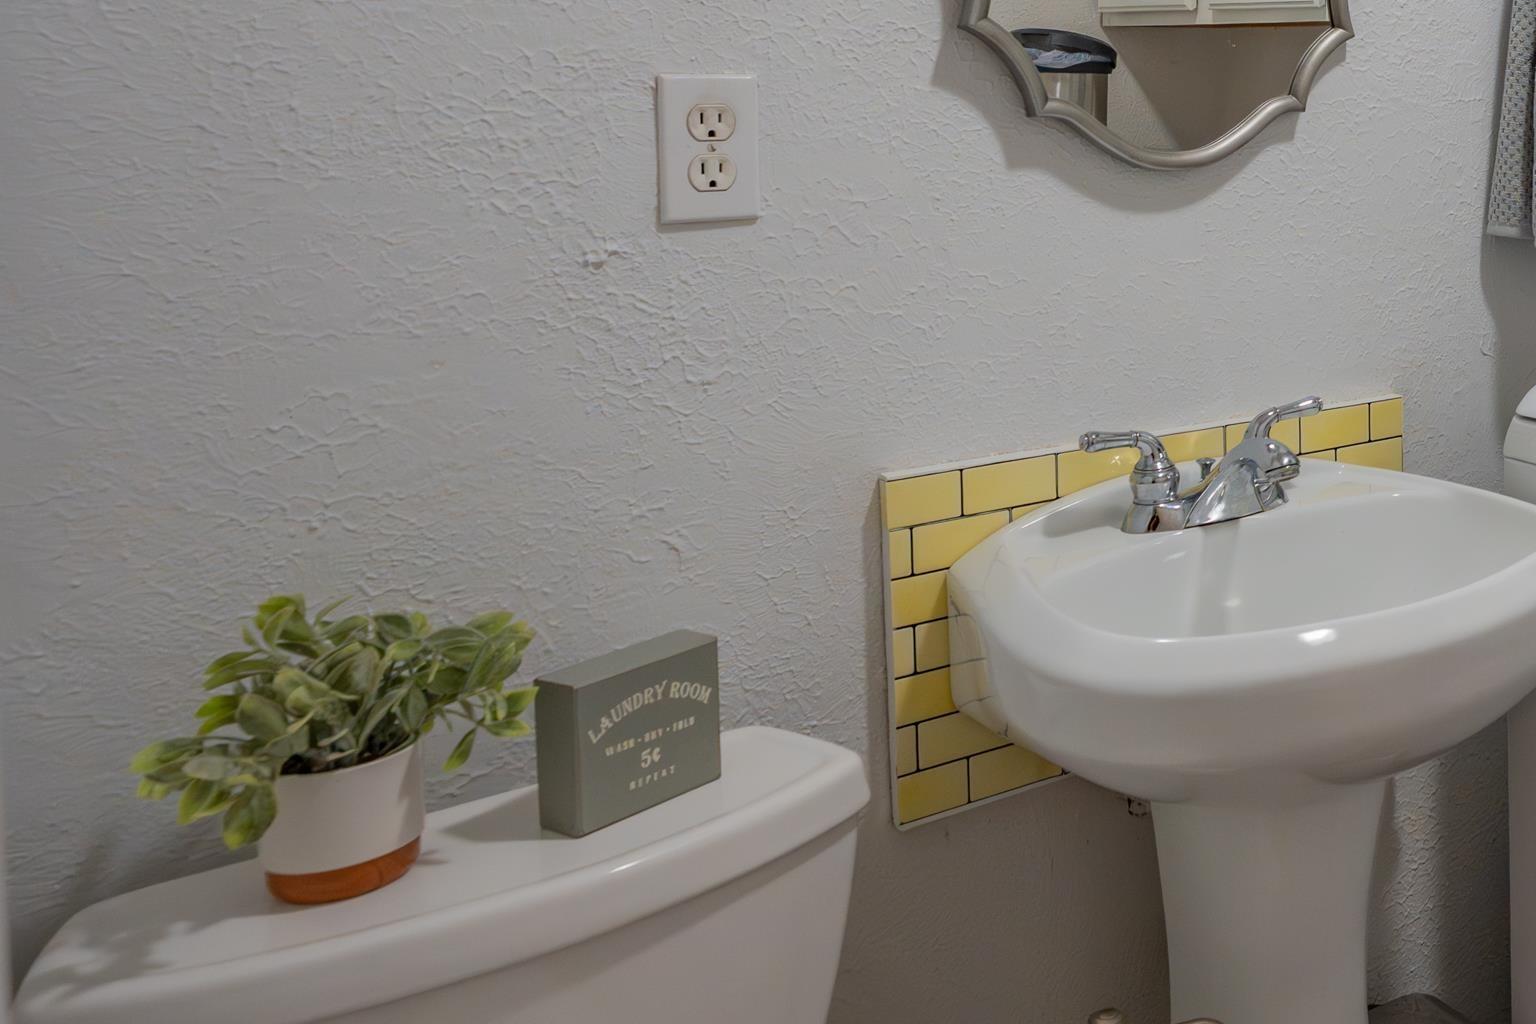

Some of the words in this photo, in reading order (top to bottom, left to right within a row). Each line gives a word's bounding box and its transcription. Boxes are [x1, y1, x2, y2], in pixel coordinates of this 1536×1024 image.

[587, 679, 669, 745] LAUNDRY
[669, 681, 713, 705] ROOM
[640, 747, 661, 768] 5¢
[629, 765, 676, 791] REPEAT
